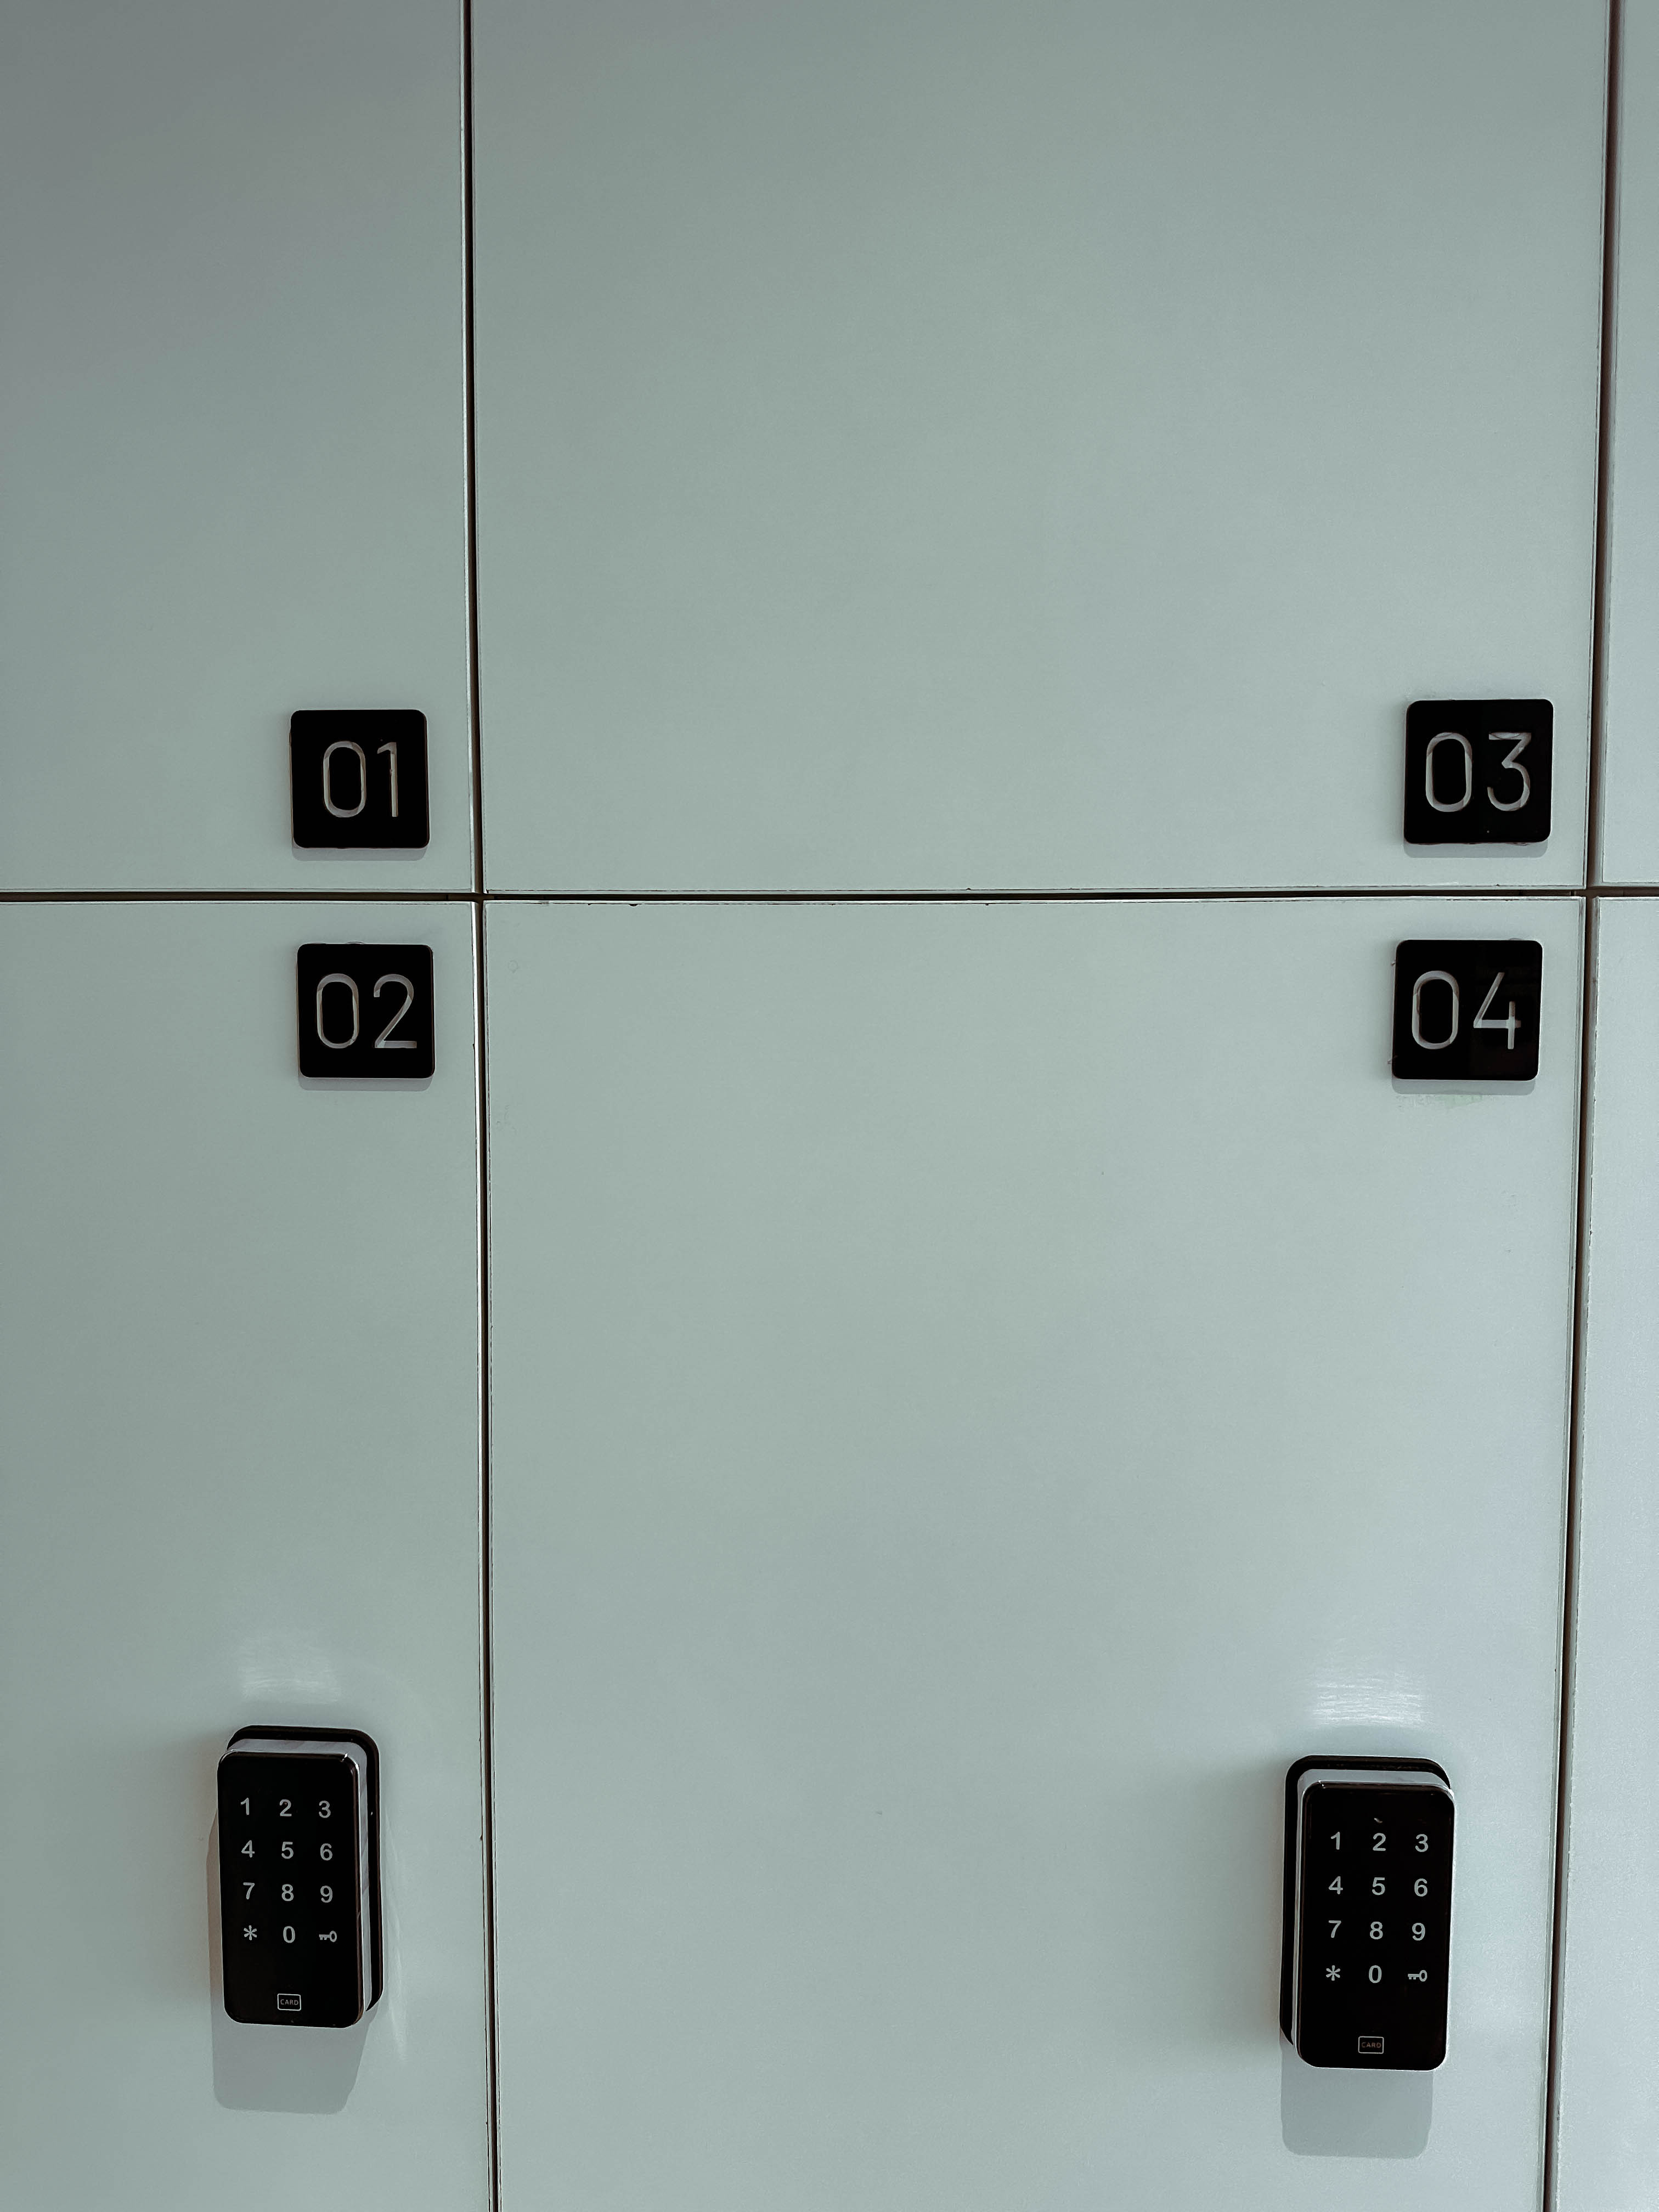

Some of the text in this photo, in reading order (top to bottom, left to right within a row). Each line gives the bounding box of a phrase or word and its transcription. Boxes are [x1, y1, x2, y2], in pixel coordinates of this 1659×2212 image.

[323, 741, 398, 818] 01
[1425, 732, 1531, 812] 03
[316, 973, 417, 1049] 02
[1411, 970, 1521, 1049] 04
[240, 1797, 331, 1818] 1 2 3
[241, 1840, 333, 1861] 4 5 6
[1330, 1831, 1429, 1853] 1 2 3
[243, 1882, 333, 1903] 7 8 9
[1328, 1876, 1428, 1897] 4 5 6
[283, 1926, 296, 1943] 0
[1328, 1920, 1426, 1941] 7 8 9
[1368, 1965, 1382, 1984] 0
